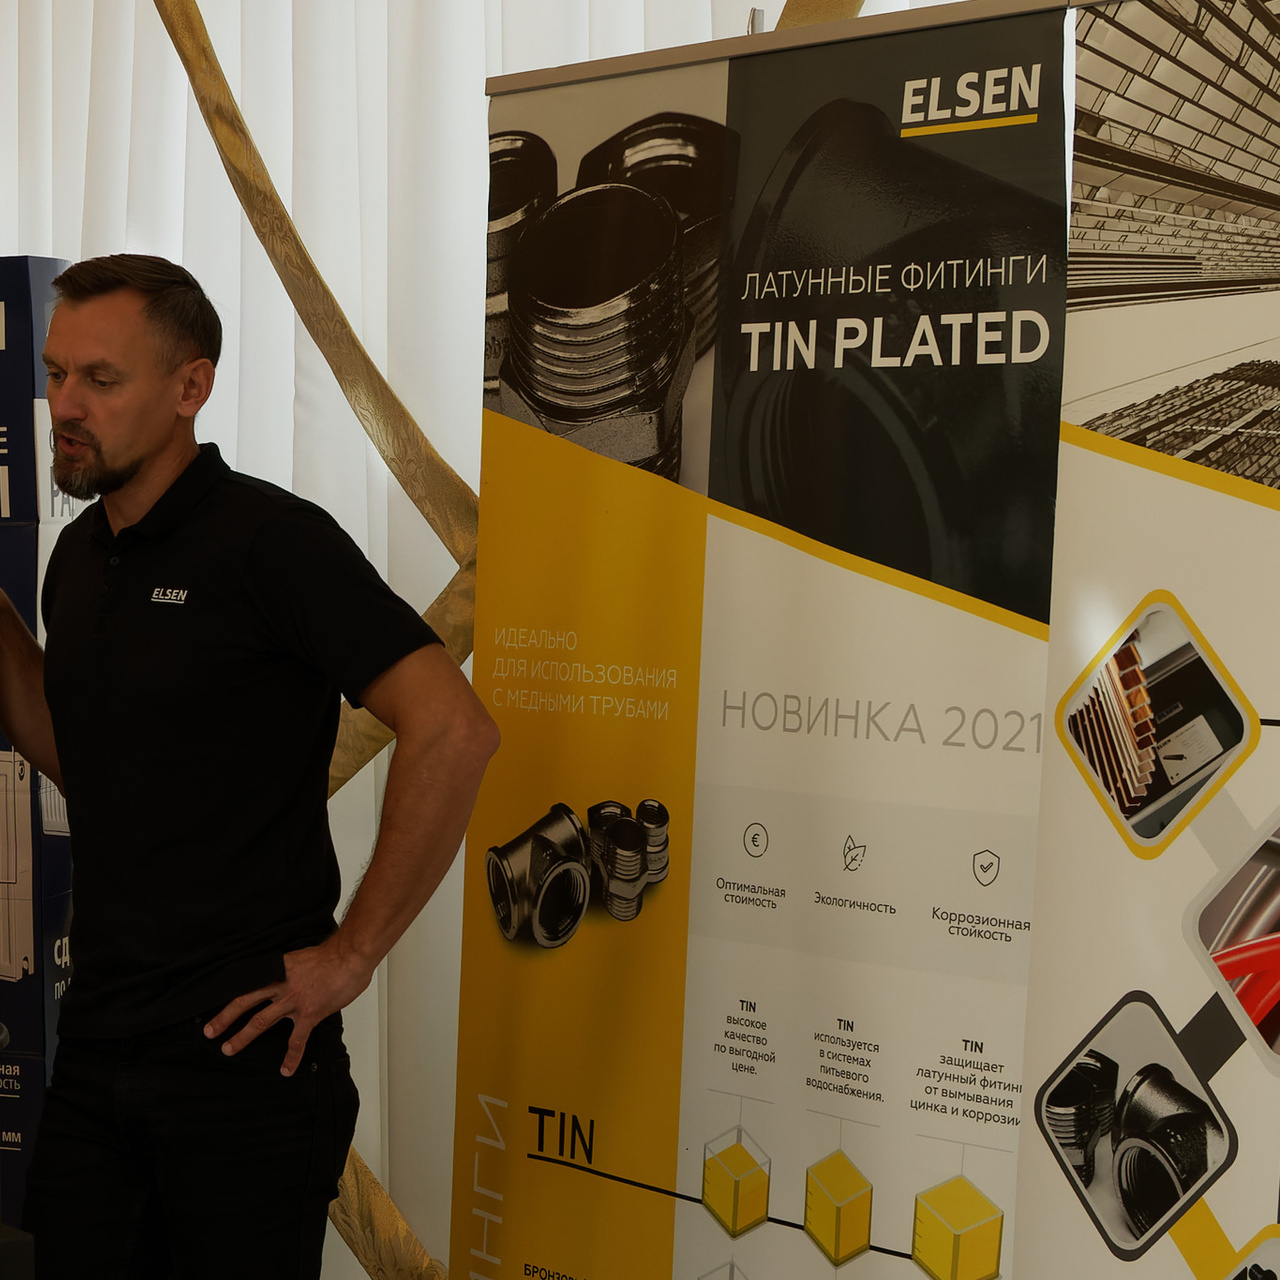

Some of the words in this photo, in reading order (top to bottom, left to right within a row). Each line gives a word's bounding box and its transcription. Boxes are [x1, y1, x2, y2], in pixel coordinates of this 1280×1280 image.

[901, 63, 1041, 124] ELSEN
[741, 263, 893, 301] ЛАТУННЫЕ
[900, 254, 1048, 294] ФИТИНГИ
[741, 320, 818, 372] TIN
[834, 309, 1050, 369] PLATED
[152, 587, 188, 601] ELSEN
[493, 626, 578, 652] ИДЕАЛЬНО
[492, 656, 527, 681] ДЛЯ
[529, 658, 678, 688] ИСПОЛЬЗОВАНИЯ
[506, 687, 585, 714] МЕДНЫМИ
[590, 692, 670, 721] ТРУБАМИ
[723, 689, 927, 747] НОВИНКА
[943, 706, 1044, 754] 2021
[715, 877, 786, 898] Оптимальная
[723, 892, 778, 910] стоимость
[814, 891, 897, 915] Экологичность
[931, 907, 1032, 932] Коррозионная
[947, 923, 1013, 943] стойкость
[739, 999, 757, 1013] TIN
[726, 1014, 767, 1031] высокое
[836, 1018, 854, 1032] TIN
[723, 1029, 768, 1047] качество
[813, 1032, 880, 1054] используется
[961, 1039, 984, 1054] TIN
[713, 1041, 727, 1054] по
[728, 1044, 776, 1064] выгодной
[819, 1048, 825, 1058] в
[826, 1050, 872, 1068] системах
[731, 1061, 758, 1075] цене.
[819, 1064, 869, 1084] питьевого
[938, 1054, 1005, 1074] защищает
[915, 1067, 977, 1086] латунный
[805, 1076, 885, 1103] водоснабжения.
[924, 1084, 938, 1097] от
[941, 1088, 1014, 1110] вымывания
[909, 1098, 948, 1116] цинка
[950, 1105, 959, 1117] и
[527, 1106, 596, 1165] TIN
